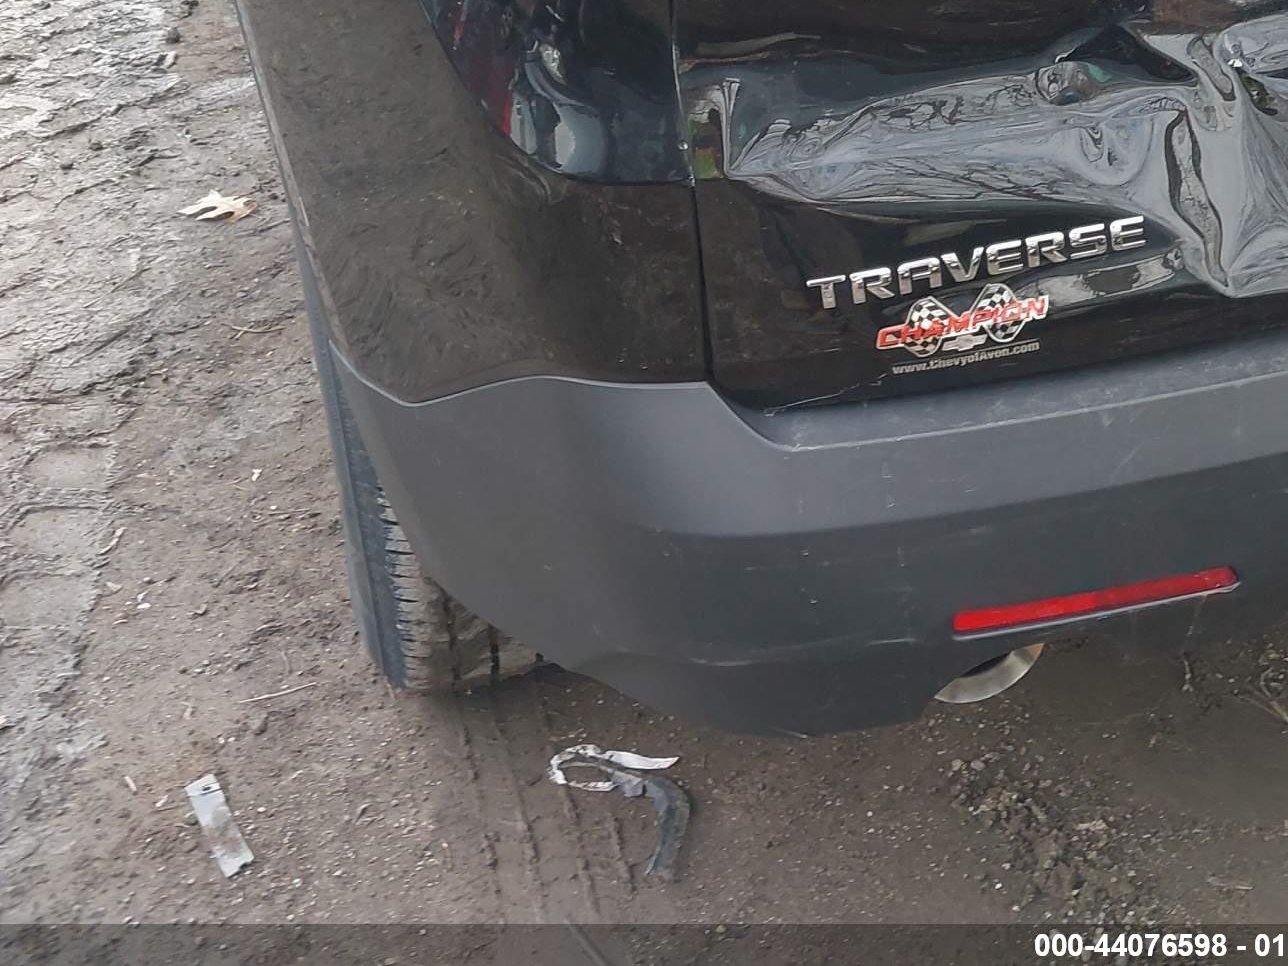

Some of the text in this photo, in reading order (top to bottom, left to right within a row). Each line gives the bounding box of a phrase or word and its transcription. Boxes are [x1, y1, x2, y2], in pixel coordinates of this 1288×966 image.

[806, 215, 1146, 309] TRAVERSE
[877, 295, 1048, 348] CHAMPION
[892, 341, 1040, 375] www.ChevyofAvon.com
